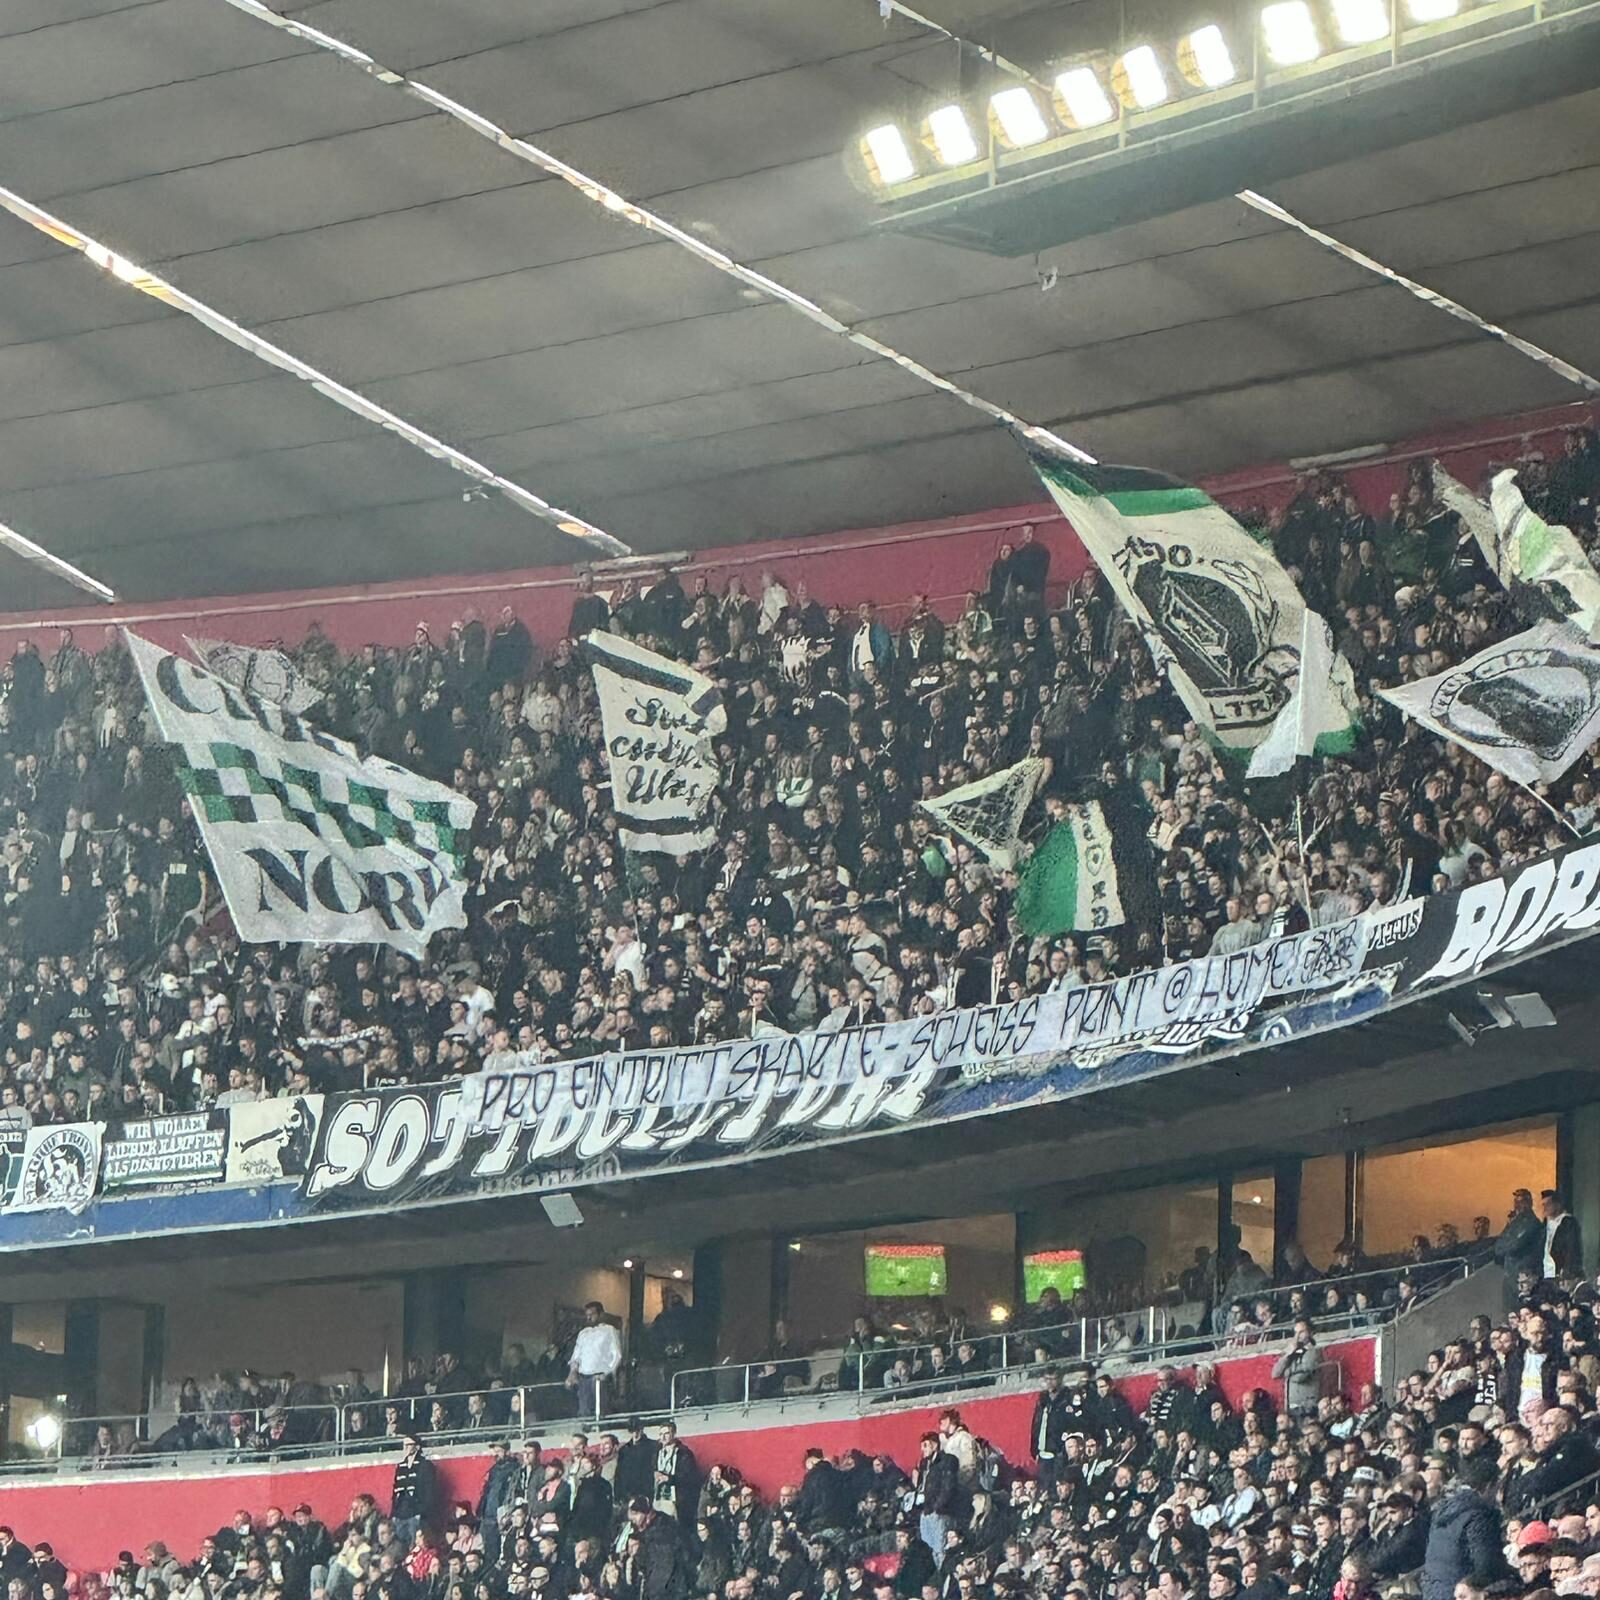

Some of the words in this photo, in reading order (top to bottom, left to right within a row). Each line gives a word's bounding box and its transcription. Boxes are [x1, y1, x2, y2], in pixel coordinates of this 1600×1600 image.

[479, 1070, 557, 1121] PRO
[904, 997, 1039, 1071] SCHEISS
[1060, 972, 1158, 1039] PRINT
[124, 1122, 151, 1139] WIR
